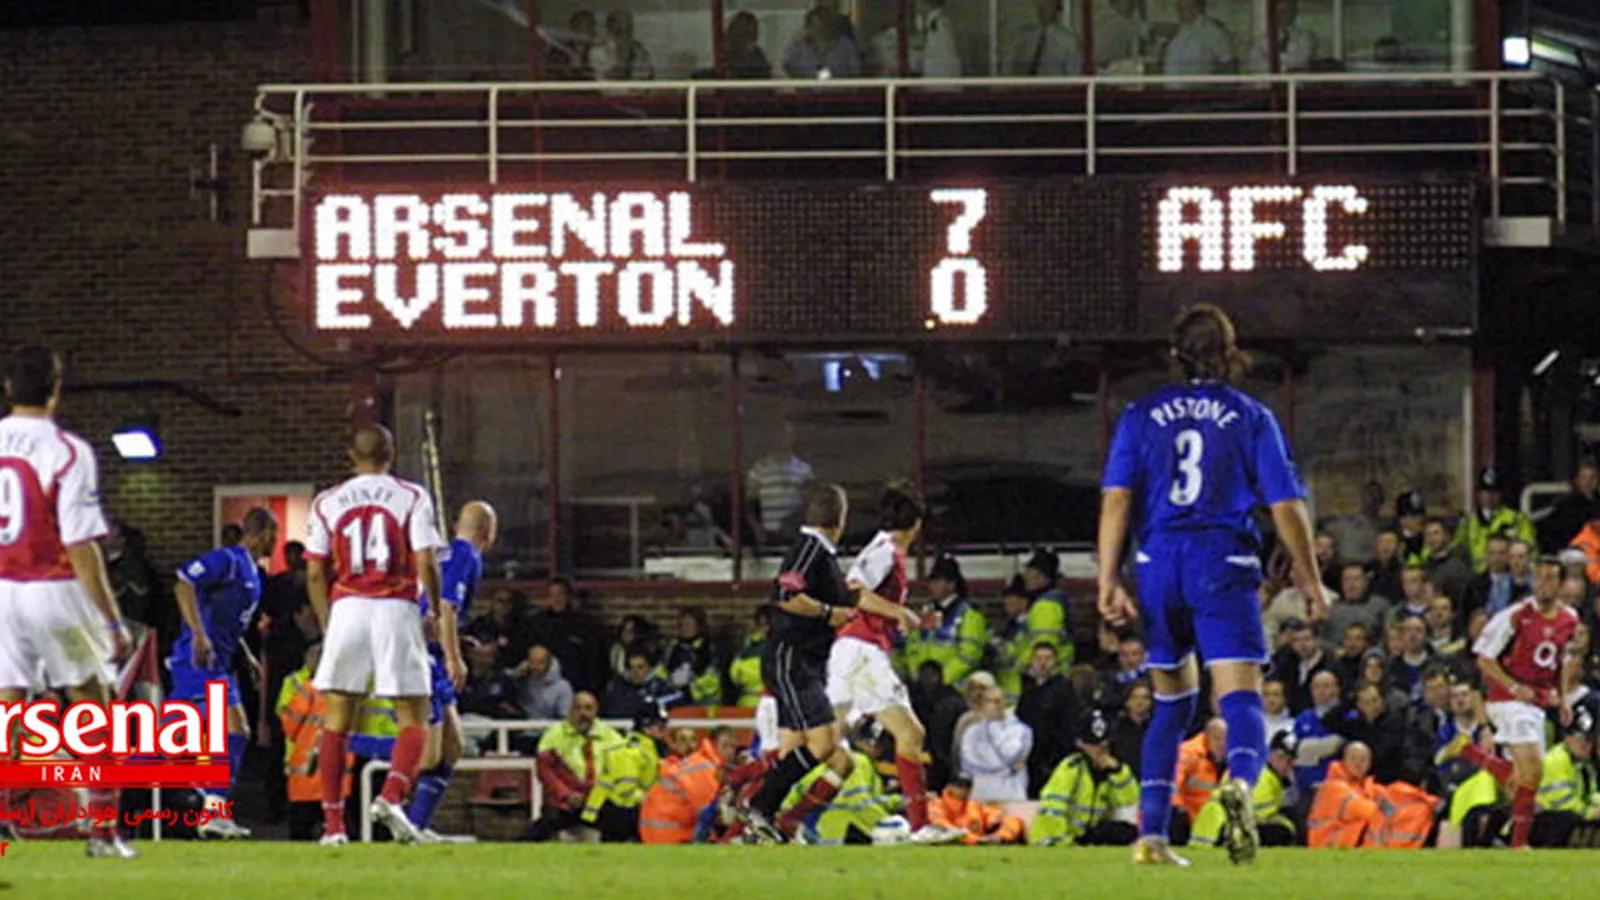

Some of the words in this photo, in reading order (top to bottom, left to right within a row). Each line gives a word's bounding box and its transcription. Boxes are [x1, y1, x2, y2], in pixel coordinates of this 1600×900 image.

[315, 192, 726, 260] ARSENAL
[930, 188, 987, 254] 7
[1157, 186, 1368, 272] AFC
[315, 260, 735, 329] EVERTON
[930, 258, 987, 324] 0
[1151, 397, 1239, 429] PISTONE
[1169, 429, 1204, 506] 3
[0, 466, 24, 545] 9
[342, 512, 390, 575] 14
